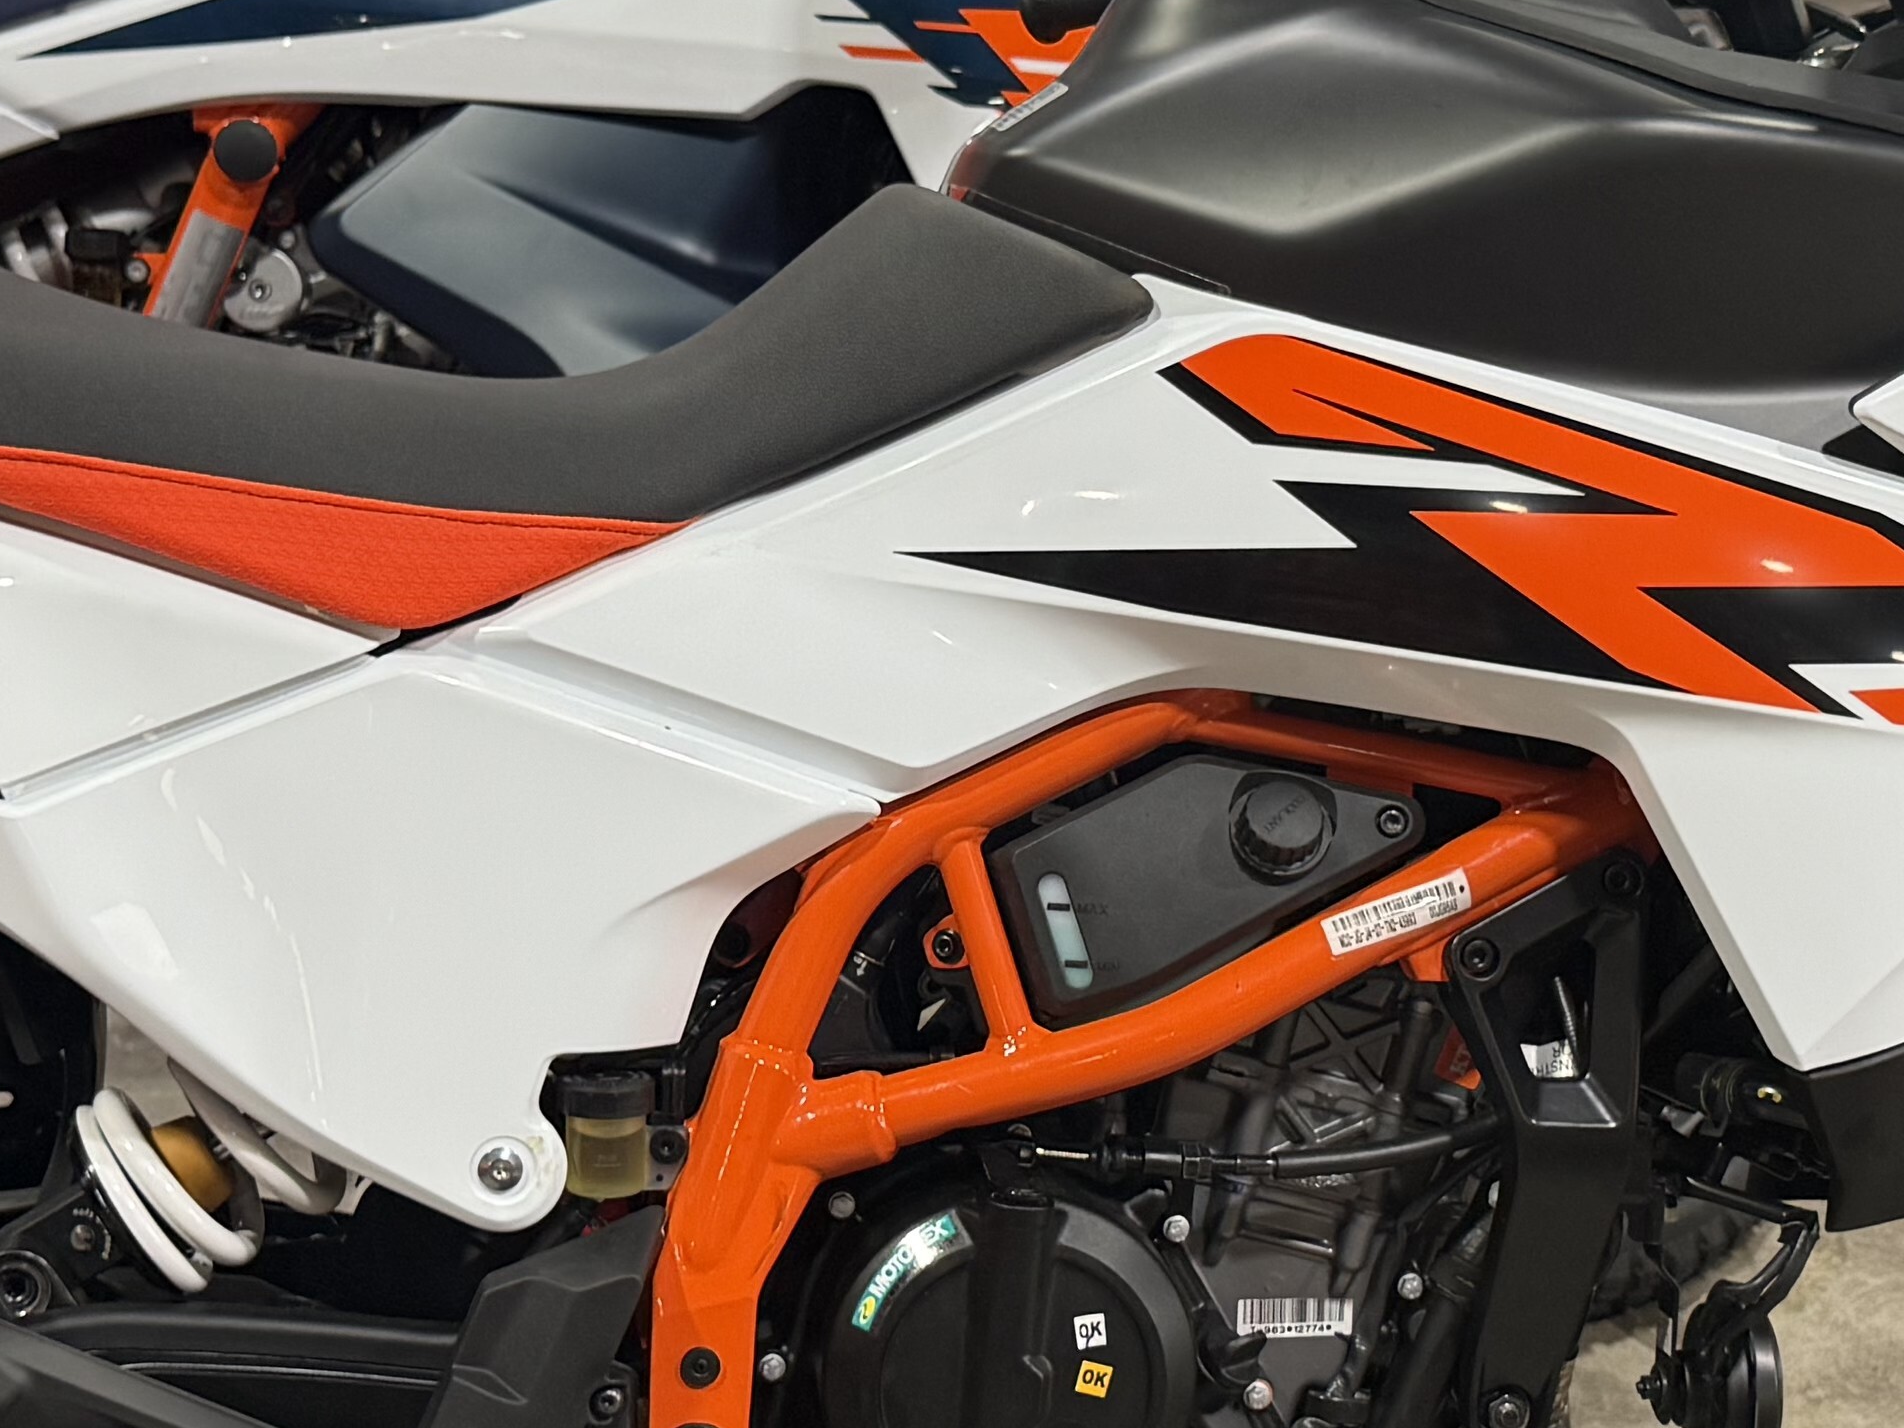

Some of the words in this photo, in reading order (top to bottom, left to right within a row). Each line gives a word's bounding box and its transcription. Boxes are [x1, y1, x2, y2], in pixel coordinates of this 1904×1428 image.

[867, 1215, 952, 1301] MOTOEX
[1078, 1320, 1103, 1340] OK
[1081, 1368, 1108, 1388] OK
